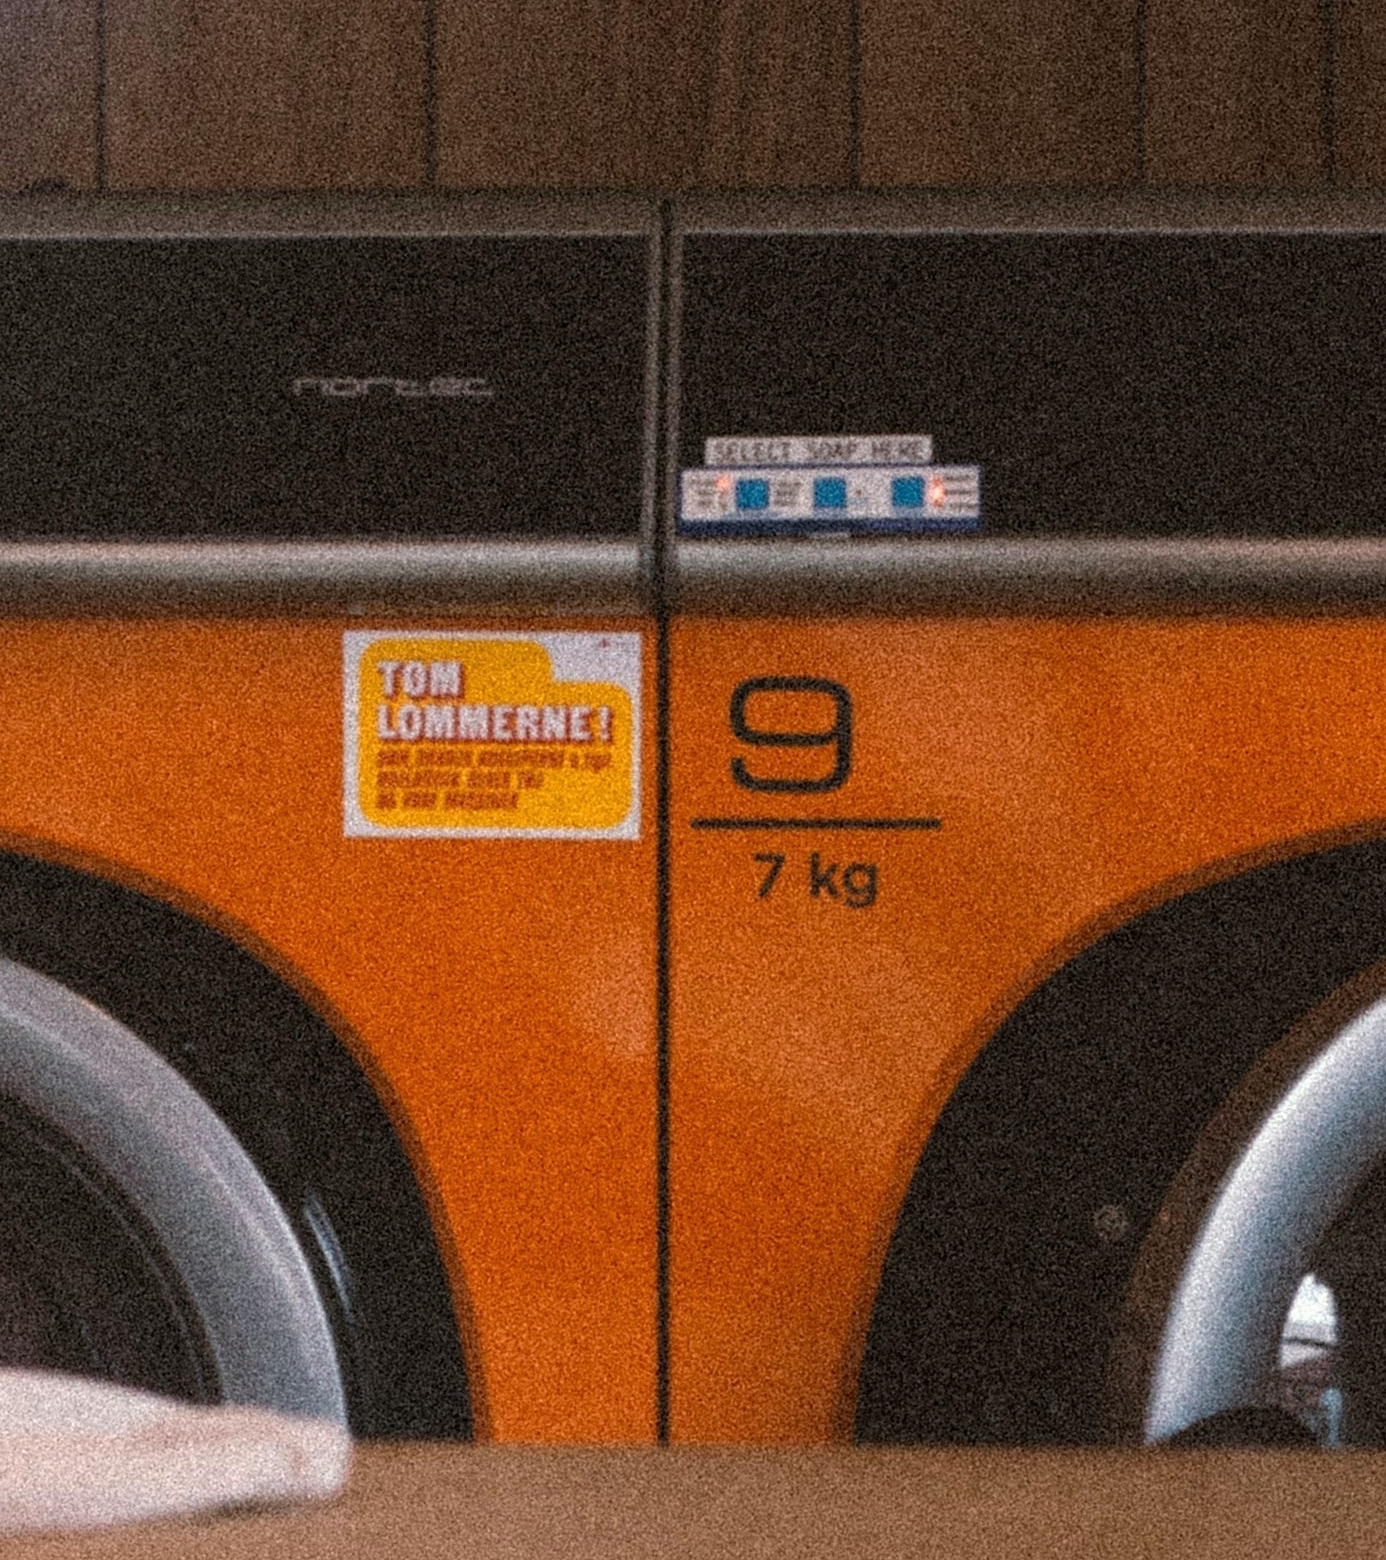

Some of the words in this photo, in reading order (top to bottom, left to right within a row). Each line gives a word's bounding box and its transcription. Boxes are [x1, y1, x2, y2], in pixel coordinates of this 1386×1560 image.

[713, 441, 791, 462] SELECT
[807, 440, 859, 461] SOAP
[870, 439, 923, 460] HERE
[376, 660, 465, 701] TOM
[376, 705, 614, 745] LOMMERNE!
[729, 675, 853, 795] 9
[753, 853, 785, 900] 7
[809, 852, 880, 909] kg
